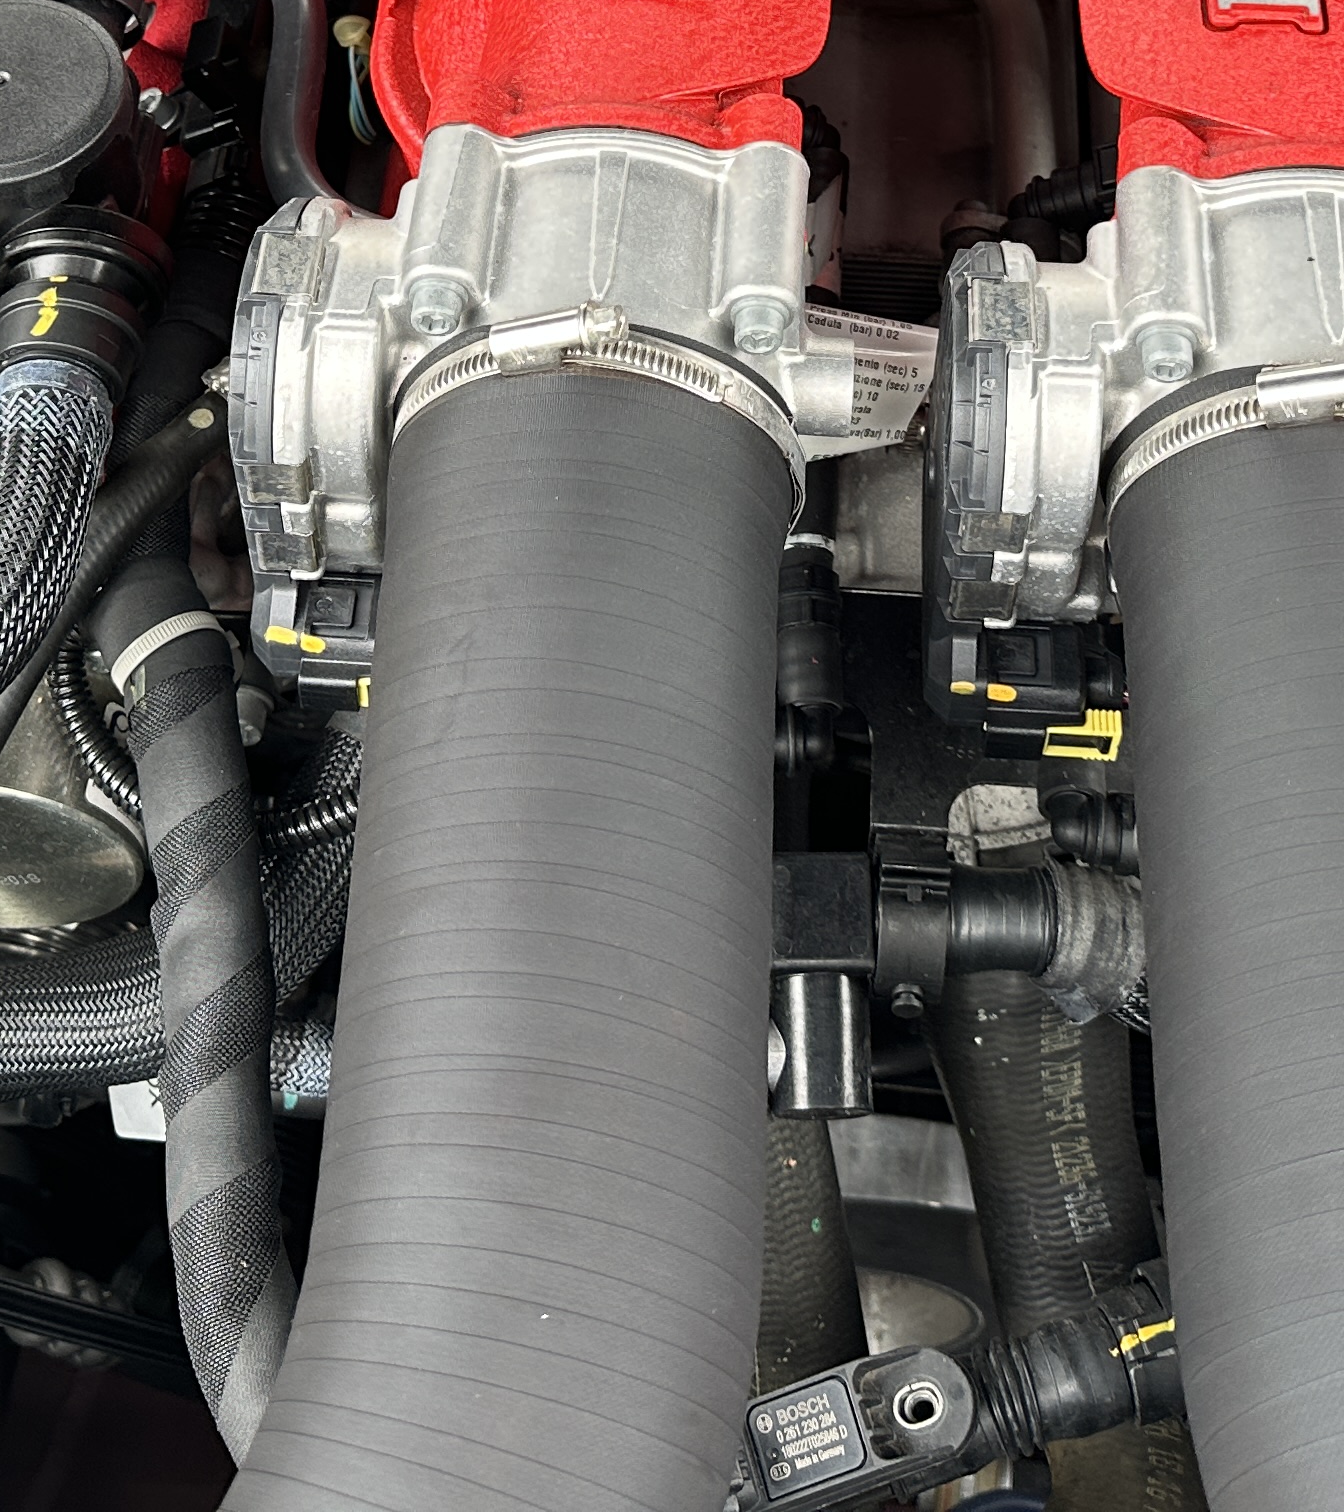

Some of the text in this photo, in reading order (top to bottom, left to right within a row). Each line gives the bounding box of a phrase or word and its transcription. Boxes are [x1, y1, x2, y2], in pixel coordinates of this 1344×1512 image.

[883, 362, 908, 379] (sec)
[910, 367, 919, 379] 5
[885, 378, 910, 393] (sec)
[866, 391, 879, 402] 10
[776, 1393, 830, 1425] BOSCH
[776, 1430, 784, 1443] 0
[784, 1423, 801, 1442] 261
[801, 1417, 819, 1435] 230
[794, 1444, 845, 1470] Made in Germany
